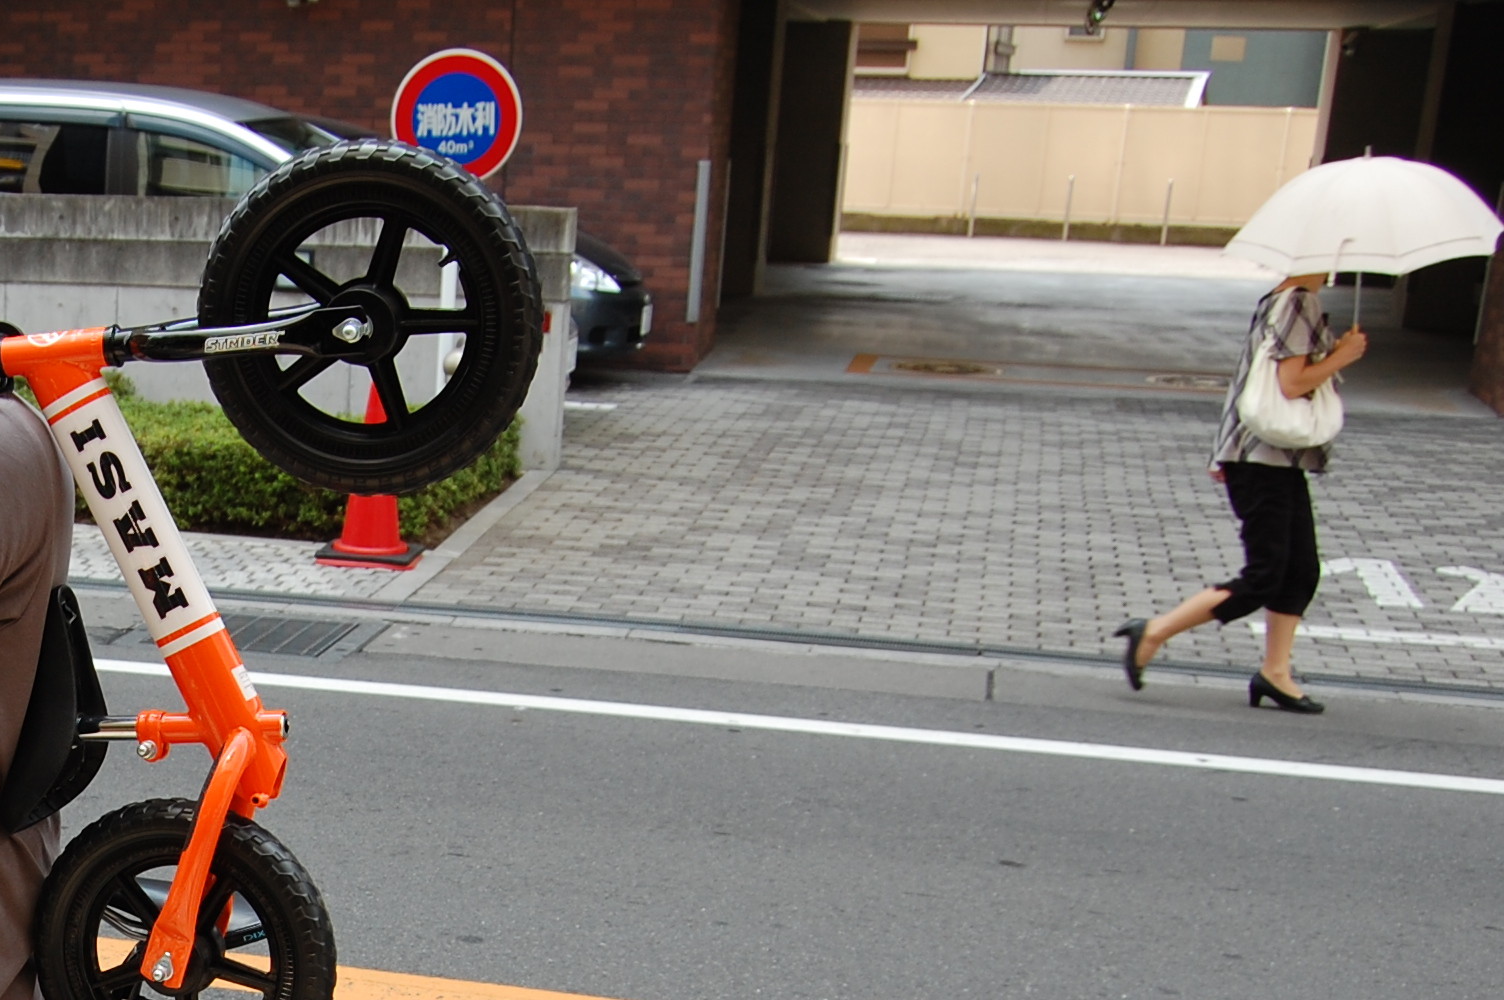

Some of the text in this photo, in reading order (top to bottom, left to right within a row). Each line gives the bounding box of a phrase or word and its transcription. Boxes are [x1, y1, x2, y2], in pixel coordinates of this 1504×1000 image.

[417, 101, 495, 137] 消防水利
[204, 330, 285, 353] STRIDER
[69, 418, 189, 620] MASI
